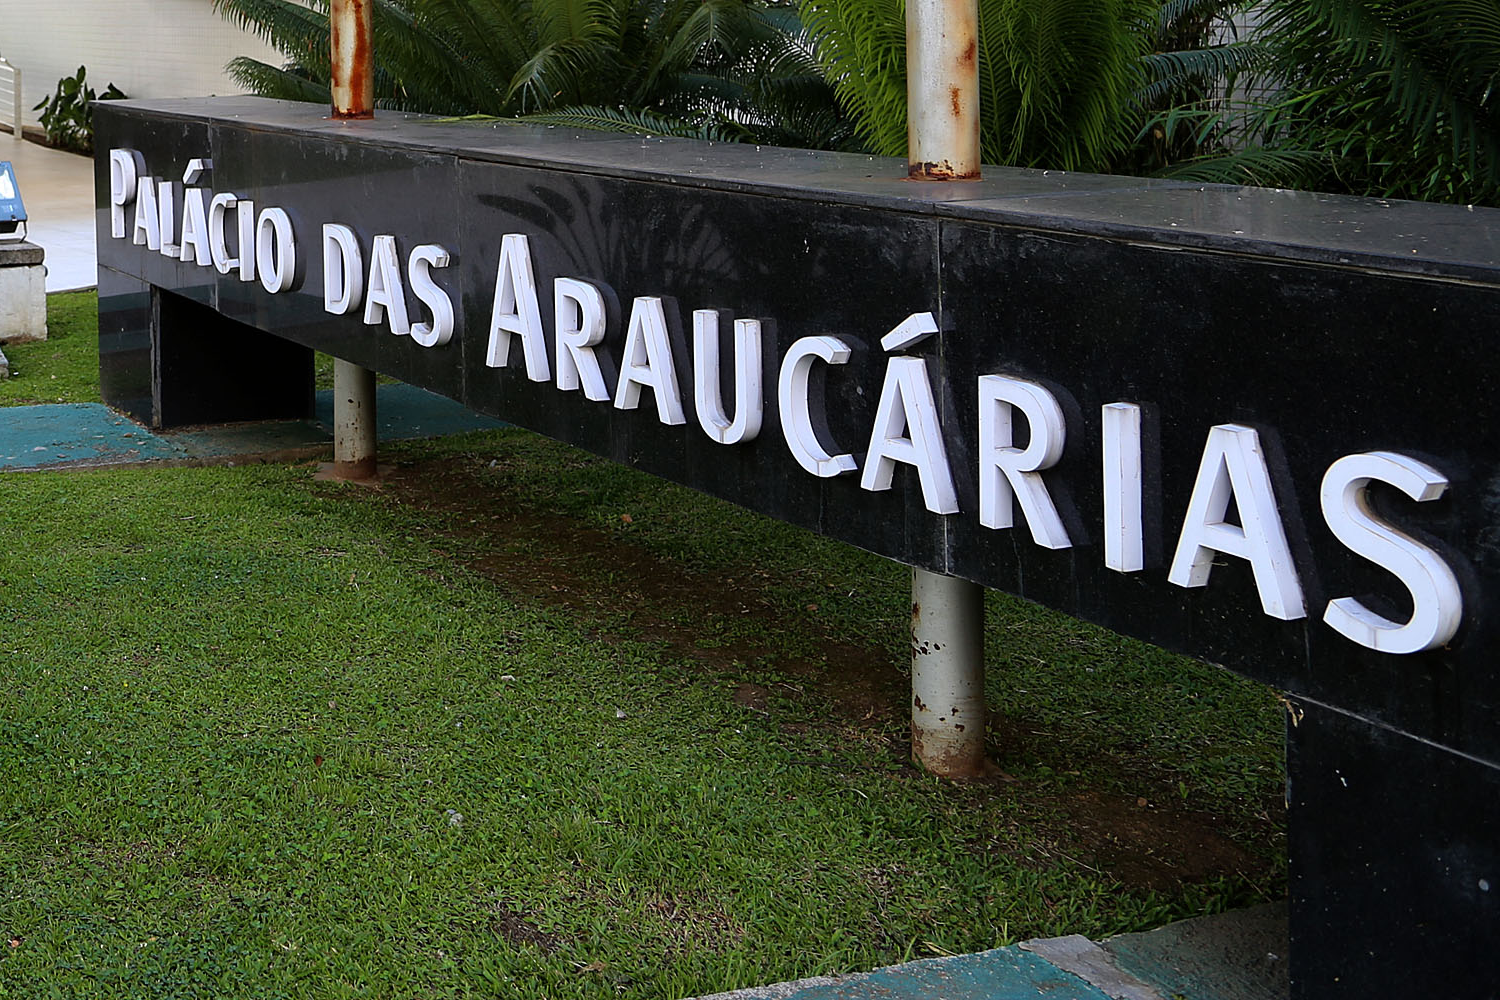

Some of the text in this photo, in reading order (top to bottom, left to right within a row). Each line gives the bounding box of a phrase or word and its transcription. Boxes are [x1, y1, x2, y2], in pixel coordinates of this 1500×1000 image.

[110, 148, 1463, 654] PALÁCIO DAS ARAUCÁRIAS
